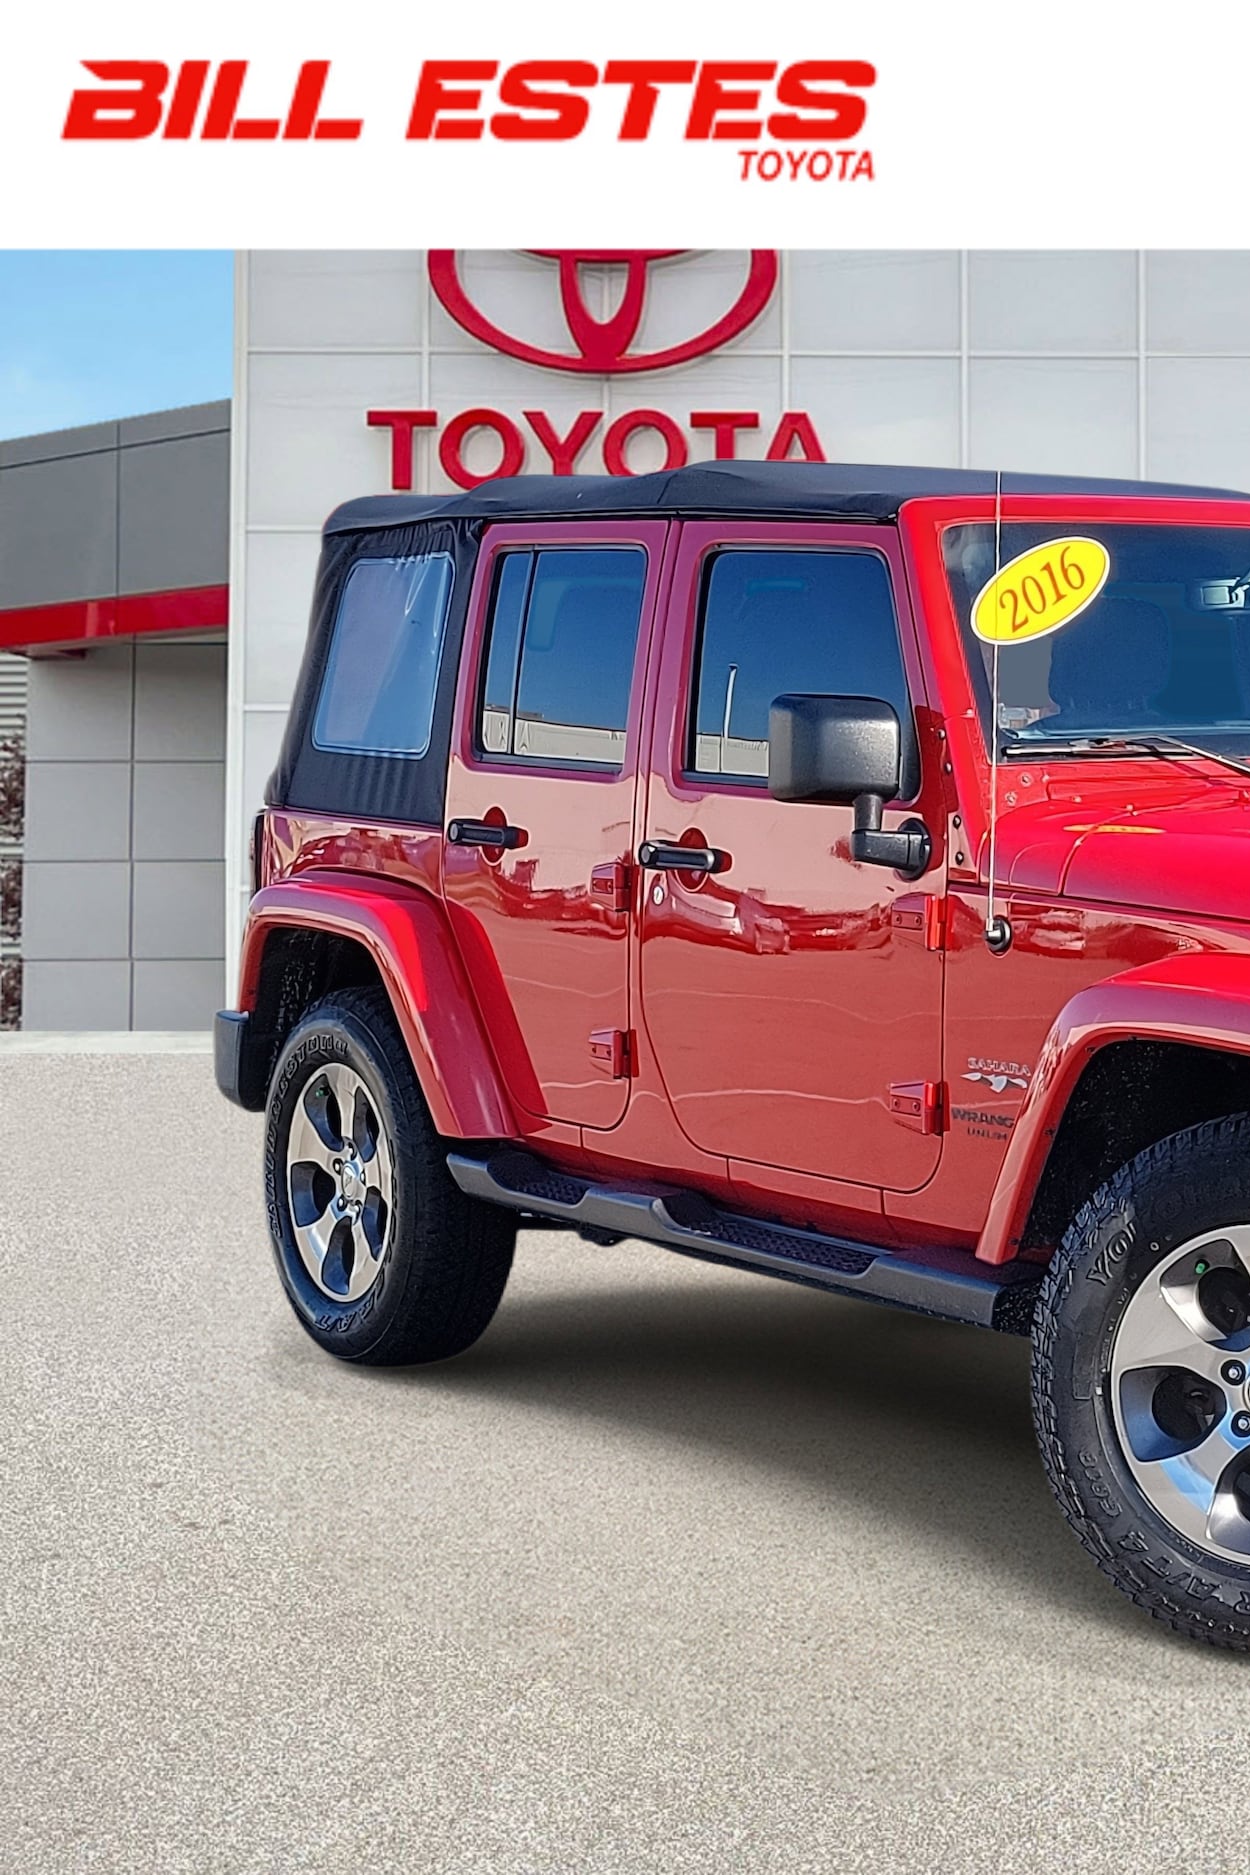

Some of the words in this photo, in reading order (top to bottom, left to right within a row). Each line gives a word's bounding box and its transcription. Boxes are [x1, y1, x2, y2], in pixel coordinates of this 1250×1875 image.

[366, 407, 828, 491] TOYOTA
[999, 546, 1086, 633] 2016
[967, 1057, 1032, 1077] SAHARA
[952, 1107, 1015, 1128] WRANG
[967, 1126, 1008, 1140] UNLIM
